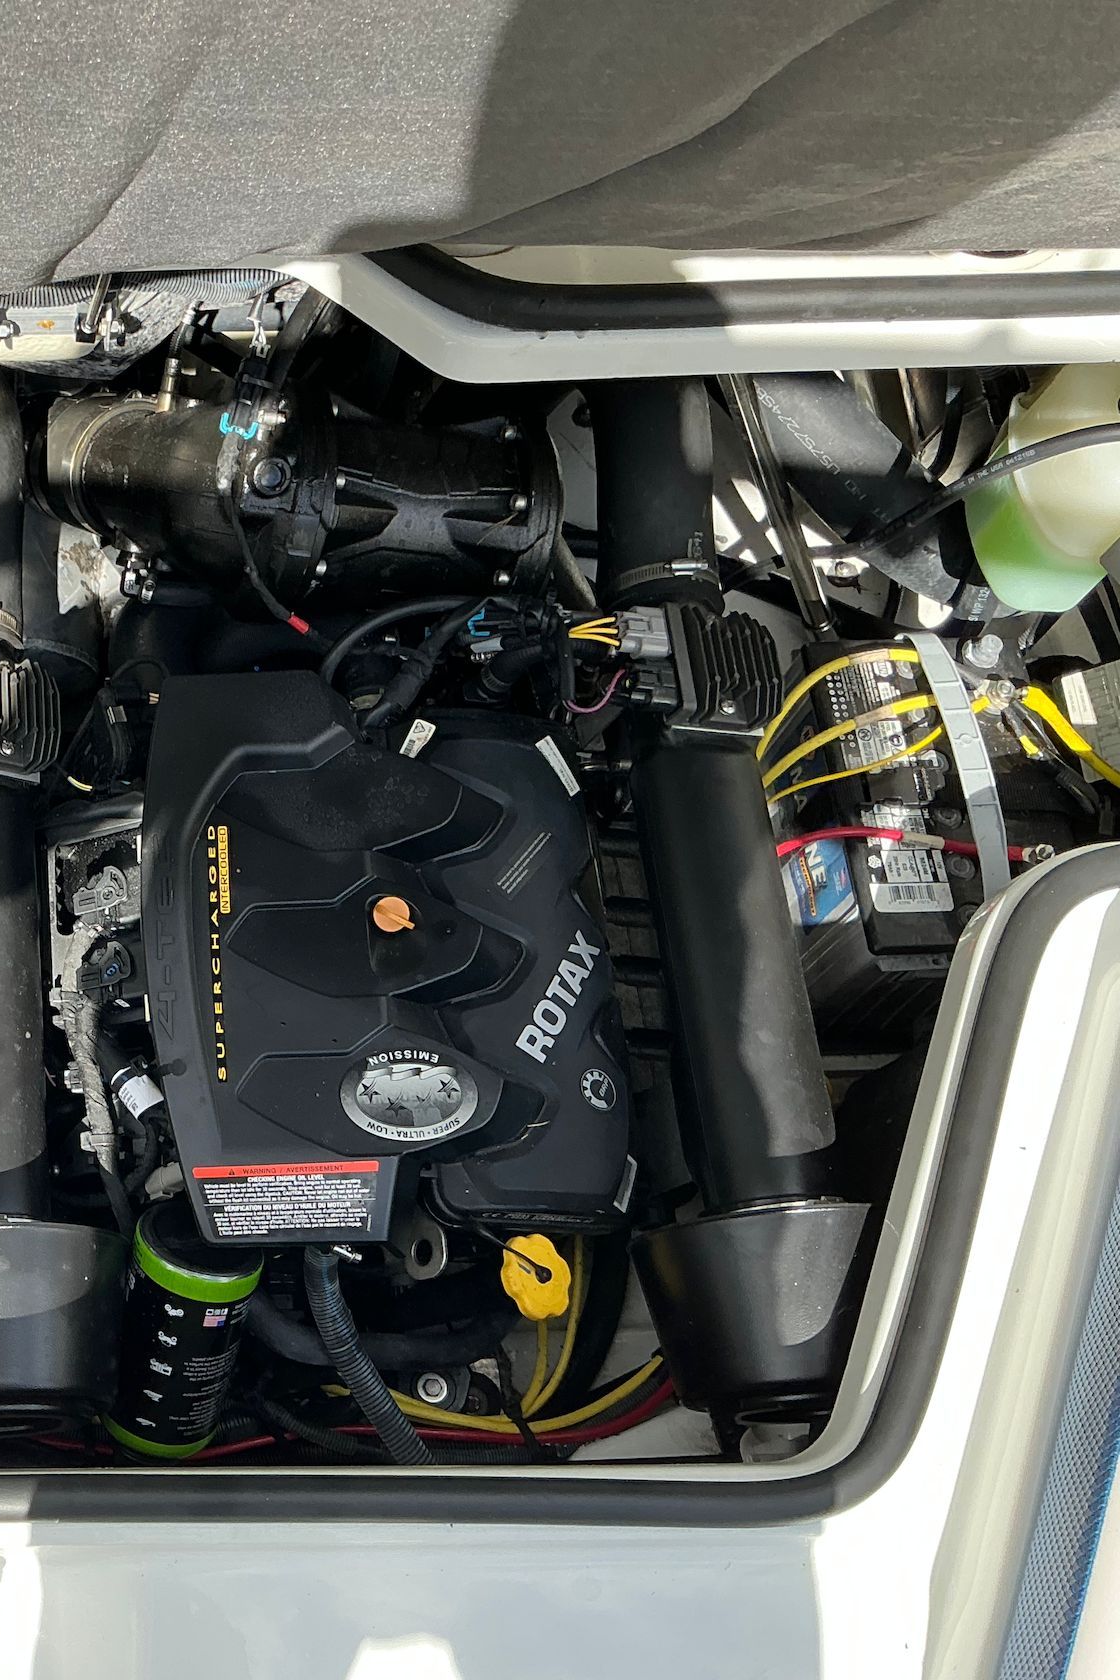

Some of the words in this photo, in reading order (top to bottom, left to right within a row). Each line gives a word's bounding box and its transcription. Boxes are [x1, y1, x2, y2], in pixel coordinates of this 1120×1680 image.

[218, 826, 229, 912] INTERCOOLED
[207, 825, 228, 1082] SUPERCHARGED
[515, 929, 601, 1064] ROTAX
[368, 1050, 439, 1066] EMISSION
[366, 1121, 388, 1135] LOW
[396, 1127, 425, 1139] ULTRA
[433, 1117, 460, 1135] SUPER
[286, 1165, 344, 1174] AVERTISSEMENT
